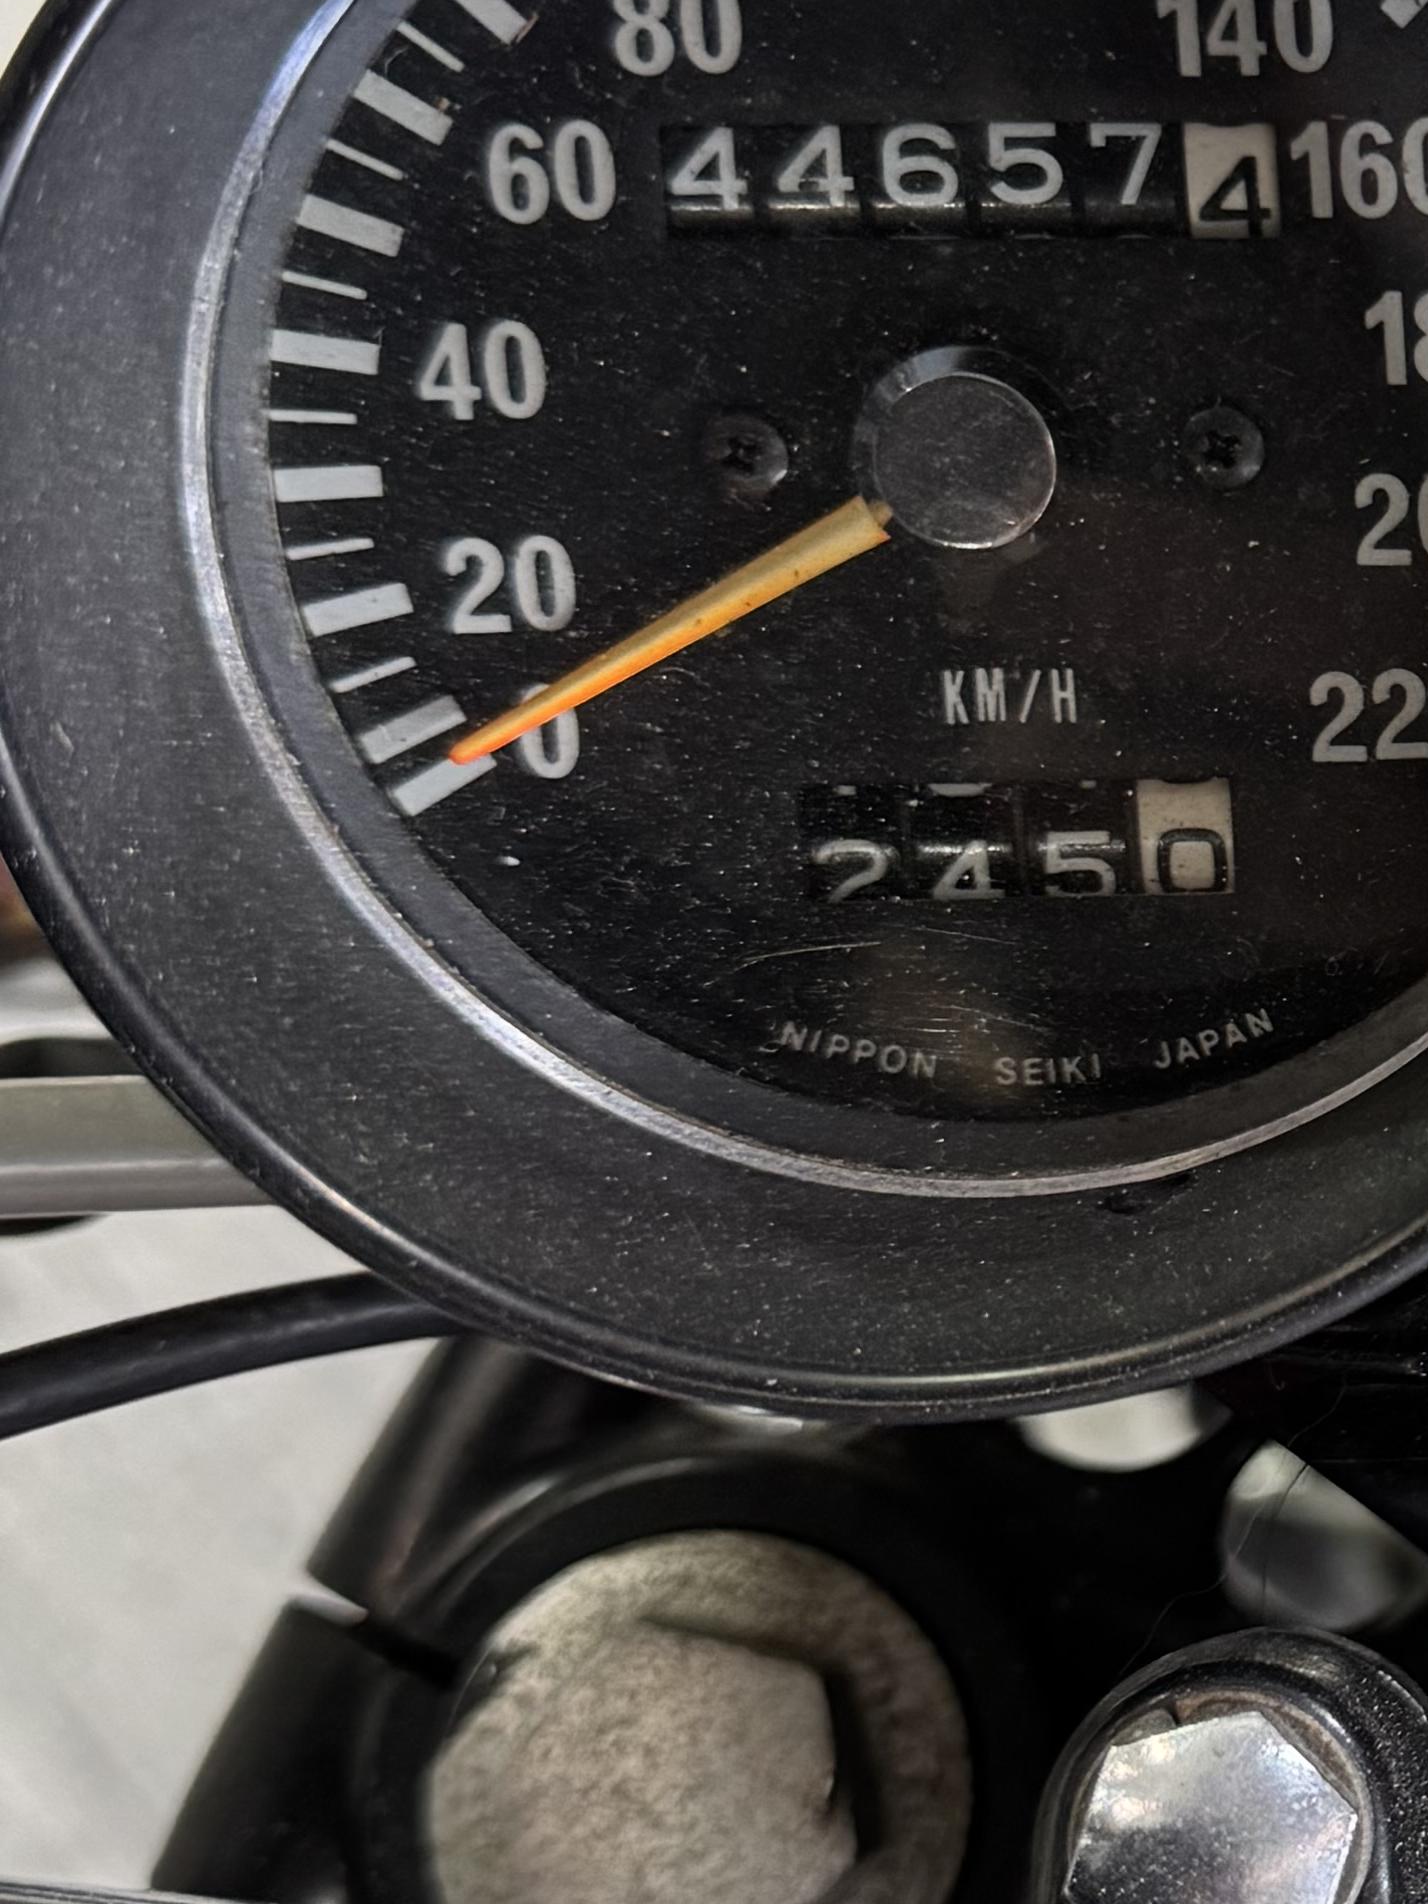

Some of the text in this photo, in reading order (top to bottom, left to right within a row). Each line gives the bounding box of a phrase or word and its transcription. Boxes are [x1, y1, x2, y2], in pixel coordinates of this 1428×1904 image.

[487, 120, 615, 224] 60
[418, 320, 546, 420] 40
[443, 535, 576, 634] 20
[519, 683, 580, 779] 0
[943, 667, 1077, 725] KM/H
[780, 1007, 1275, 1087] NIPPON SEIKI JAPAN
